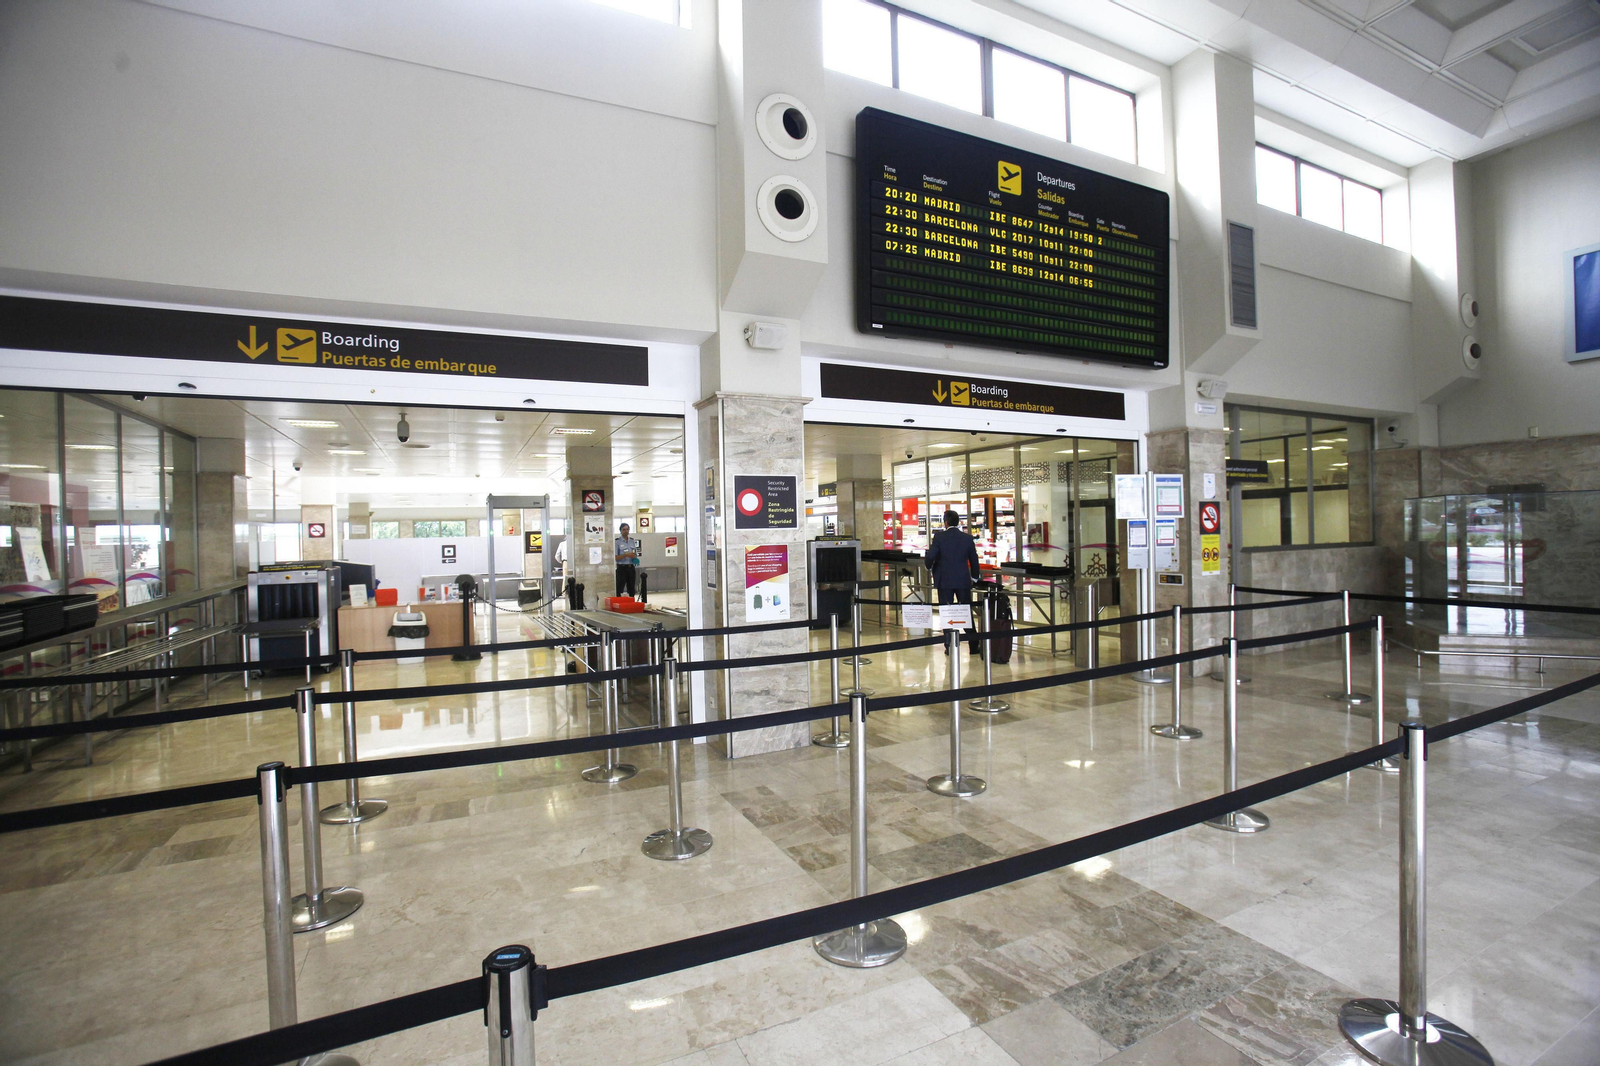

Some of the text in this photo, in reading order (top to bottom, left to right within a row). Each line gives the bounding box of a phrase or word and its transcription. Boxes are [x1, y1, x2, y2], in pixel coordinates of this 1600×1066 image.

[884, 165, 896, 173] Time
[884, 173, 897, 181] Hora
[923, 174, 948, 185] Destination
[923, 182, 942, 191] Destino
[1037, 171, 1076, 191] Departures
[988, 191, 1000, 199] Flight
[1037, 189, 1065, 204] Salidas
[885, 188, 1103, 245] 20:20 MADRID IBE 8647 12a14 19:50 2
[885, 205, 917, 219] 22:30
[925, 213, 978, 232] BARCELONA
[1012, 233, 1033, 244] 2017
[1039, 239, 1063, 251] 10a11
[1069, 246, 1093, 258] 22:00
[885, 223, 1093, 273] 22:30 BARCELONA IBE 5490 10a11 22:00
[885, 241, 1093, 288] 07:25 MADRID IBE 8639 12a14 06:55
[322, 332, 400, 352] Boarding
[322, 352, 497, 376] Puertas de embarque
[971, 384, 1008, 398] Boarding
[972, 397, 1054, 414] Puertas de embarque
